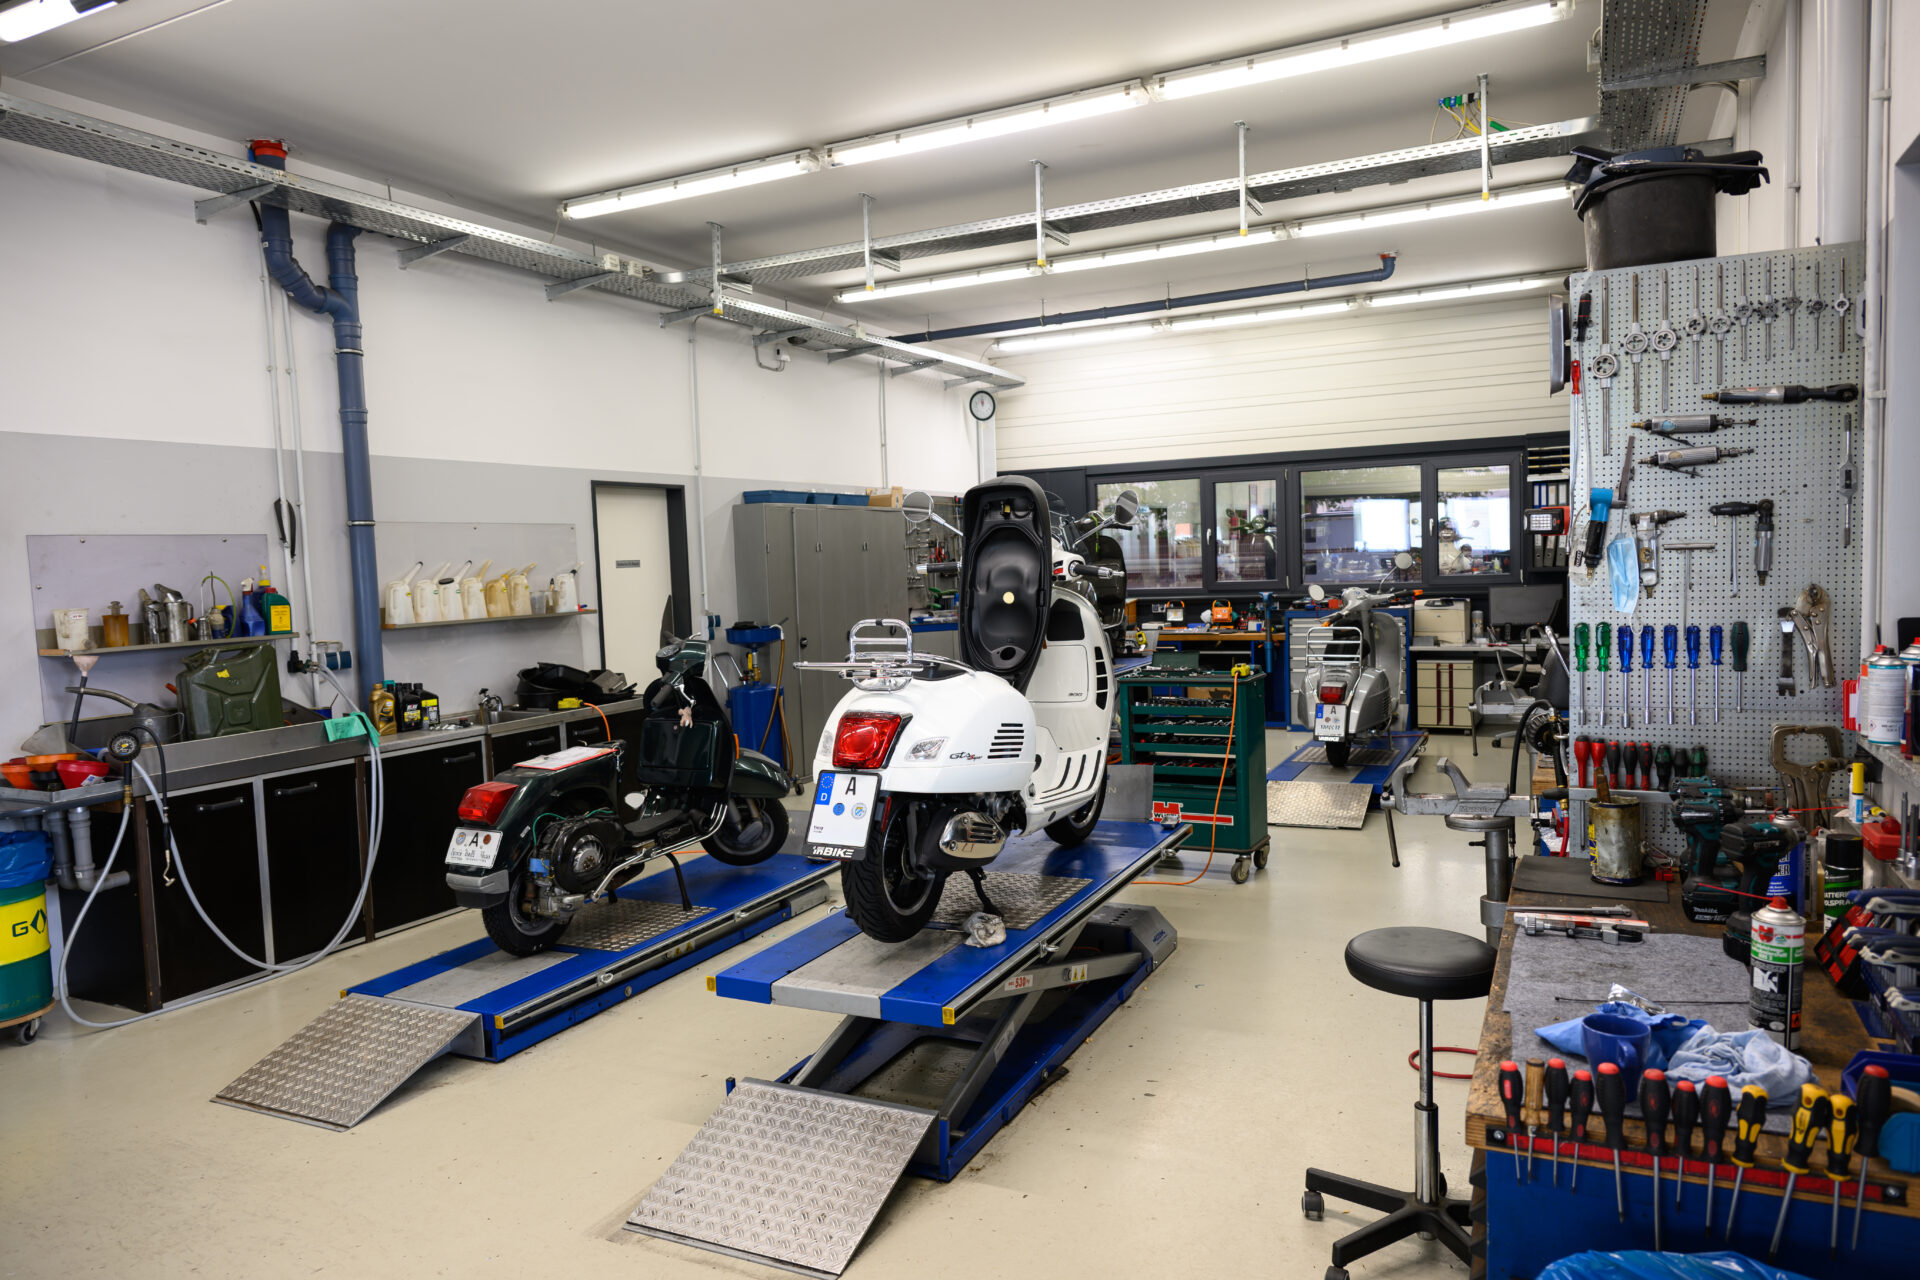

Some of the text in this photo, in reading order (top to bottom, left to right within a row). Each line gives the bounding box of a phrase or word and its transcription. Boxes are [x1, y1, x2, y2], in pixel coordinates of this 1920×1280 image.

[1330, 706, 1337, 715] A
[845, 776, 857, 796] A
[820, 792, 828, 802] D
[468, 831, 479, 848] A
